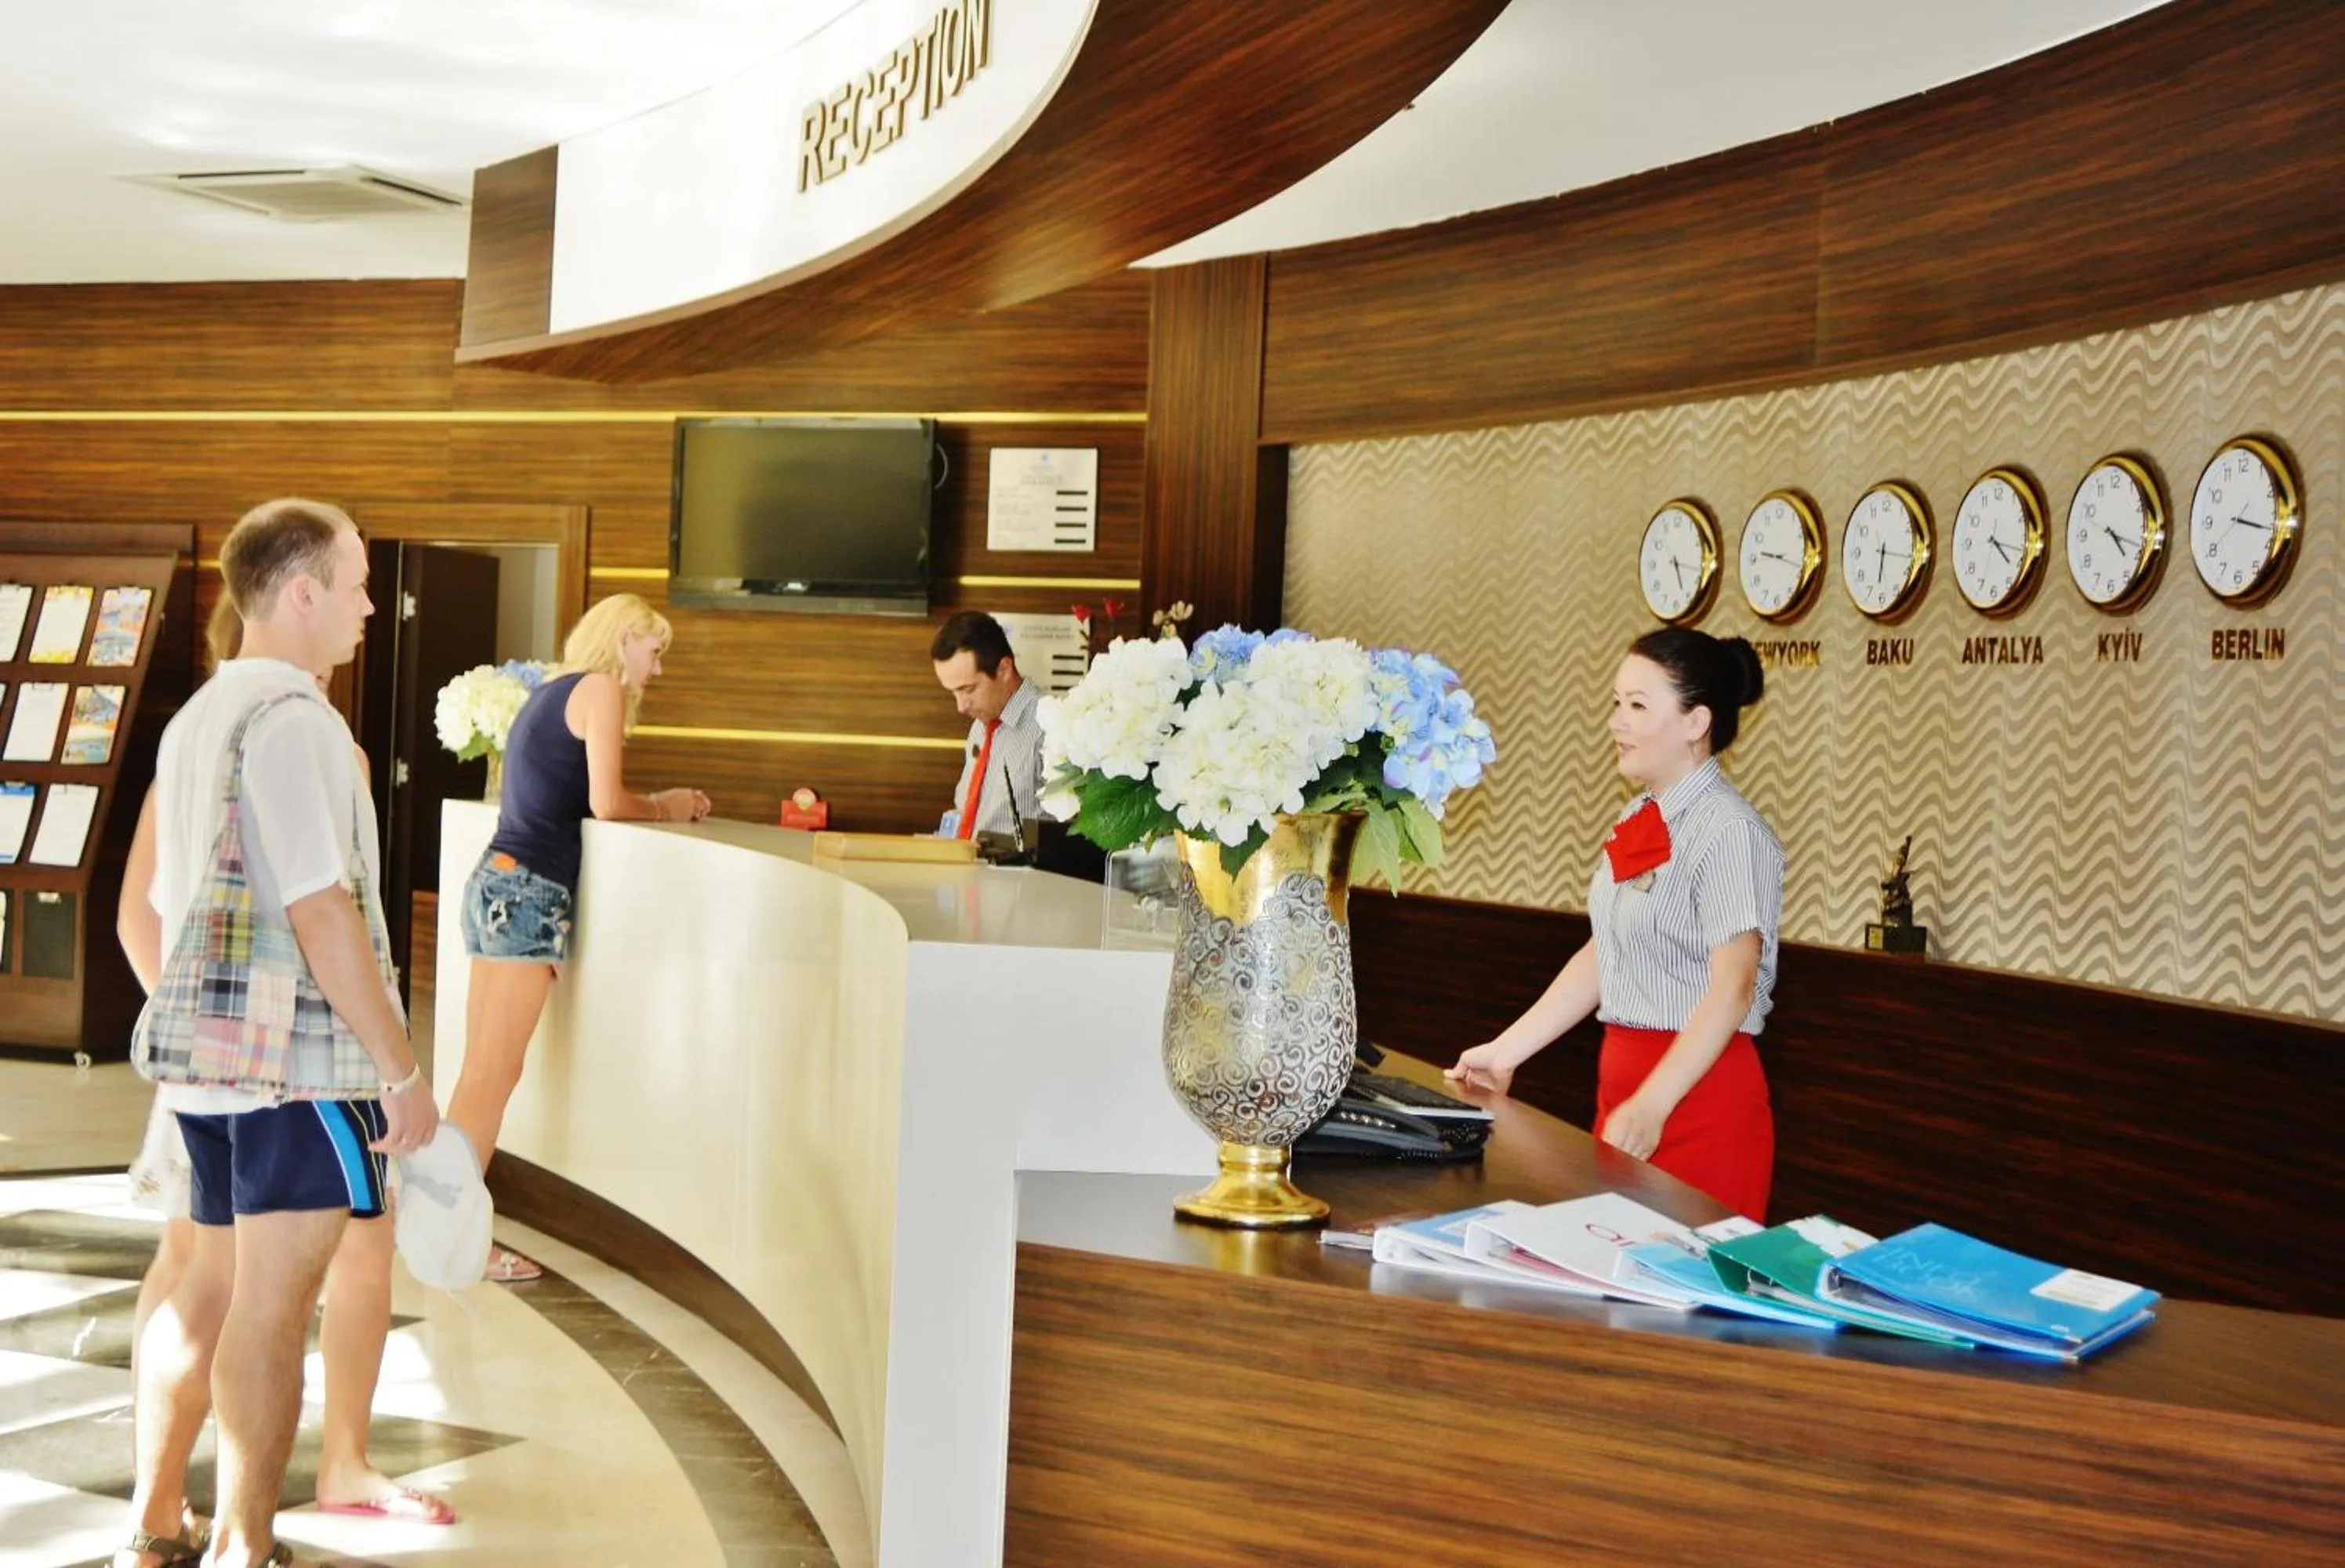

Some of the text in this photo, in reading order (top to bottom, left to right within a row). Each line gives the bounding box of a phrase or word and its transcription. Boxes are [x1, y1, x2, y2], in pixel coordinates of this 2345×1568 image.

[797, 0, 993, 194] RECEPTION
[1751, 639, 1820, 666] EWYORK
[1867, 638, 1914, 665] BAKU
[1962, 636, 2044, 664] ANTALYA
[2212, 628, 2285, 660] BERLIN
